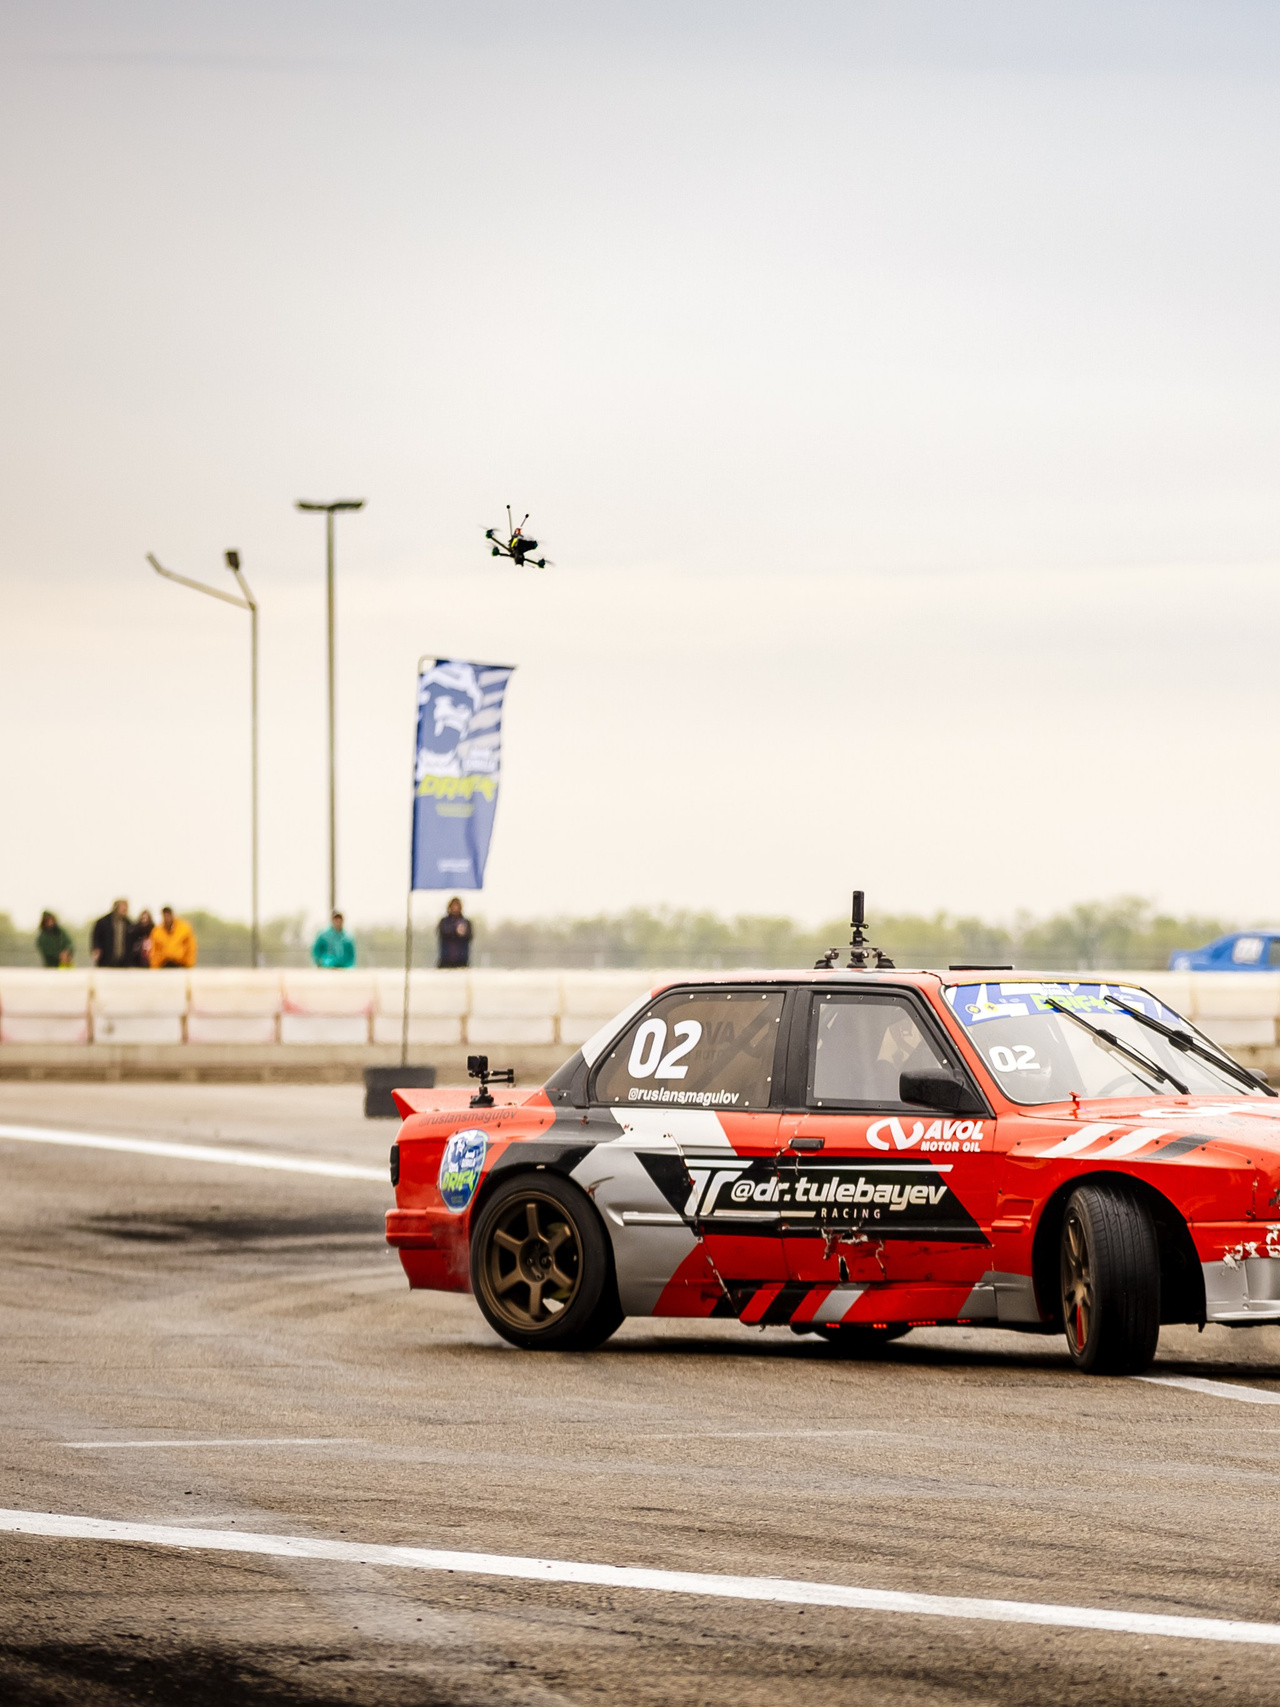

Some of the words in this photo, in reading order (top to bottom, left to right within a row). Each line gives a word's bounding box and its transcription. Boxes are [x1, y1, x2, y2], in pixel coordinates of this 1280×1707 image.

[627, 1017, 703, 1079] 02
[988, 1044, 1041, 1073] 02
[923, 1120, 984, 1141] AVOL
[920, 1141, 960, 1152] MOTOR
[962, 1142, 981, 1152] OIL
[730, 1176, 948, 1211] @dr.tulebayev
[820, 1207, 882, 1220] RACING
